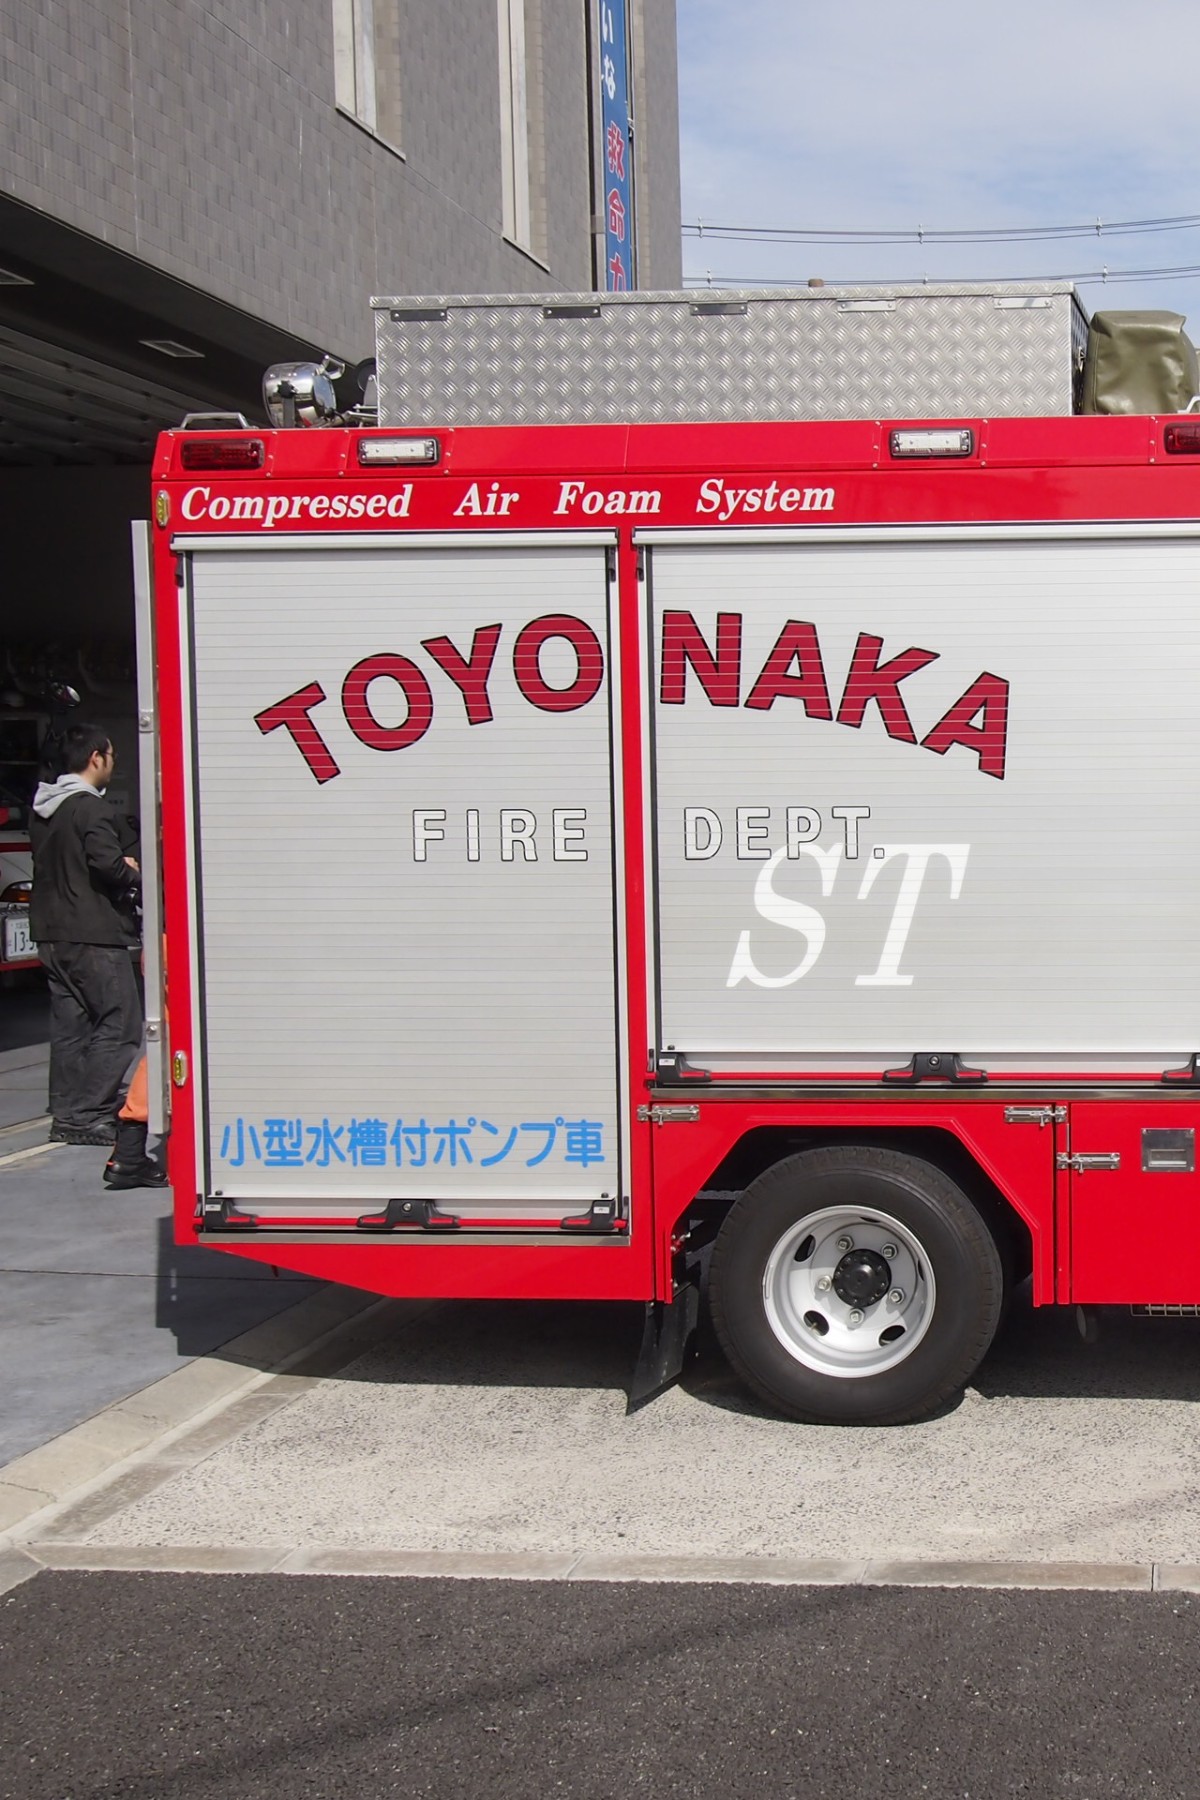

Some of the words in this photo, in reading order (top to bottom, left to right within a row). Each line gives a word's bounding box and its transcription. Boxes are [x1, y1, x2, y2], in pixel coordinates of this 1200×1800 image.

[181, 484, 414, 527] Compressed
[454, 482, 520, 517] Air
[553, 481, 662, 515] Foam
[696, 479, 836, 520] System
[412, 808, 589, 862] FIRE
[683, 806, 885, 860] DEPT.
[725, 842, 971, 988] ST
[220, 1116, 606, 1169] 小型水槽付ポンプ車
